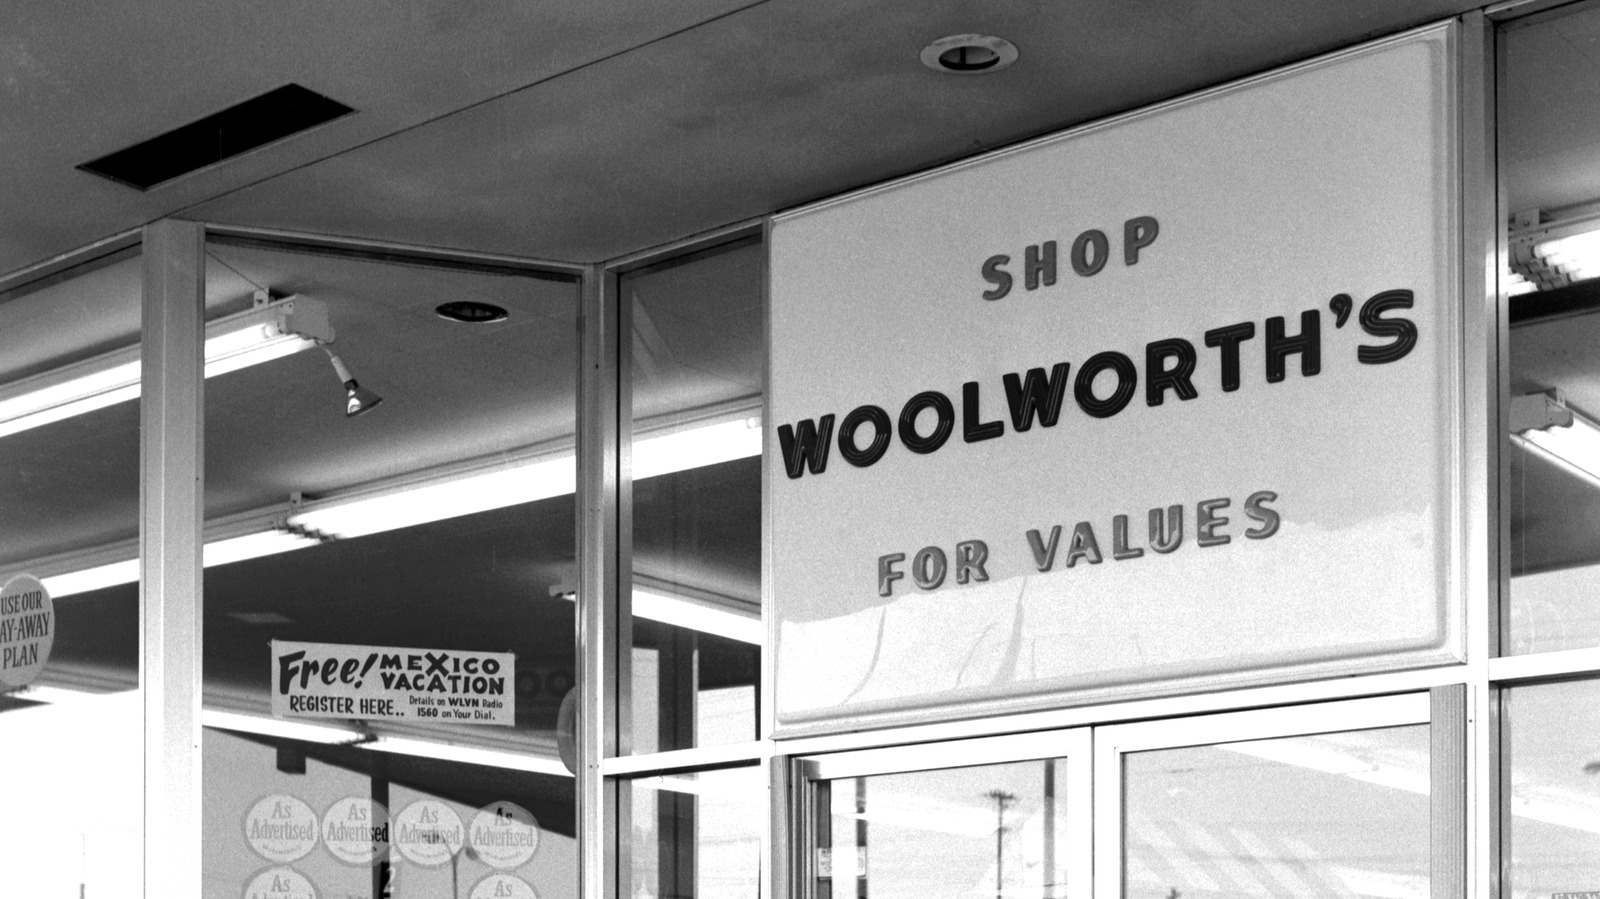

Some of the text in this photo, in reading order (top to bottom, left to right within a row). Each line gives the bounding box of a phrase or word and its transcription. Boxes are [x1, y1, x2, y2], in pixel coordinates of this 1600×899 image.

[981, 215, 1159, 301] SHOP
[777, 289, 1418, 479] WOOLWORTH'S
[878, 491, 1281, 597] FOR VALUES
[1, 590, 43, 615] USE OUR
[0, 611, 50, 643] AY-AWAY
[3, 642, 38, 669] PLAN
[380, 652, 500, 677] MEXICO
[279, 650, 378, 695] Free!
[380, 672, 505, 695] VACATION
[290, 695, 354, 714] REGISTER
[409, 695, 503, 709] Details on WLVN Radio
[417, 707, 438, 718] 1560
[453, 708, 471, 719] Your
[272, 801, 291, 819] As
[348, 803, 367, 821] As
[420, 806, 439, 824] As
[494, 807, 513, 826] As
[249, 818, 314, 841] Advertised
[327, 821, 389, 843] Advertised
[400, 823, 460, 845] Advertised
[474, 825, 533, 848] Advertised
[271, 874, 291, 892] As
[494, 880, 513, 898] As
